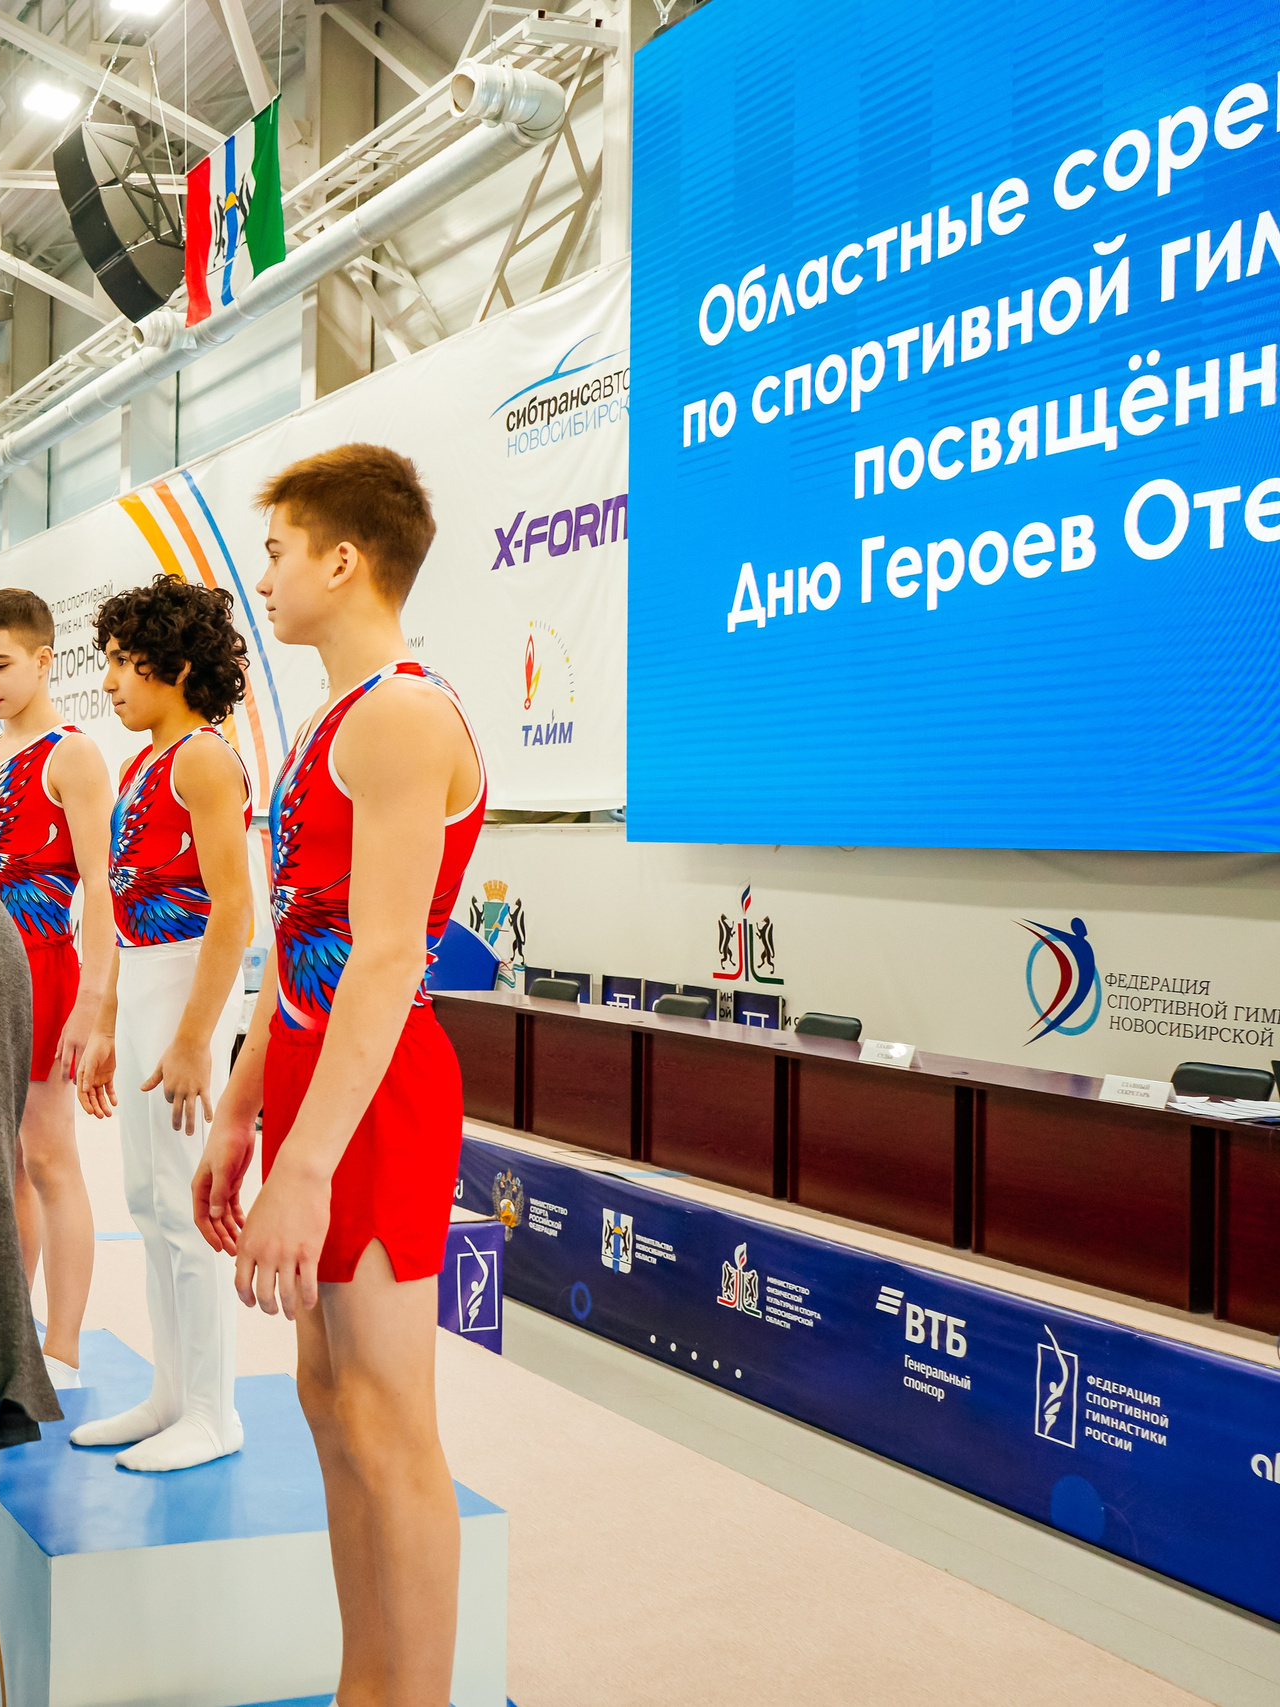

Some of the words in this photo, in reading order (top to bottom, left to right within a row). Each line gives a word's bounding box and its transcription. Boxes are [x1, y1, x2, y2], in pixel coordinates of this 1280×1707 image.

[698, 177, 1029, 346] Областные
[1053, 71, 1280, 210] соре
[683, 390, 737, 448] по
[751, 234, 1130, 424] спортивной
[854, 343, 1278, 499] посвящённ
[491, 494, 628, 571] X-FORM
[727, 561, 842, 632] Дню
[861, 514, 1096, 611] Героев
[67, 580, 114, 612] СПОРТИВНОЙ
[522, 710, 573, 746] ТАЙМ
[1104, 972, 1211, 996] ФЕДЕРАЦИЯ
[1106, 994, 1228, 1020] СПОРТИВНОЙ
[1233, 1005, 1280, 1024] ГИМ
[1109, 1015, 1274, 1047] НОВОСИБИРСКОЙ
[905, 1302, 967, 1358] ВТБ
[903, 1375, 945, 1402] спонсор
[904, 1353, 971, 1390] Генеральный
[1085, 1391, 1169, 1428] СПОРТИВНОЙ
[1086, 1374, 1161, 1408] ФЕДЕРАЦИЯ
[1084, 1426, 1133, 1452] РОССИИ
[1085, 1408, 1167, 1446] ГИМНАСТИКИ
